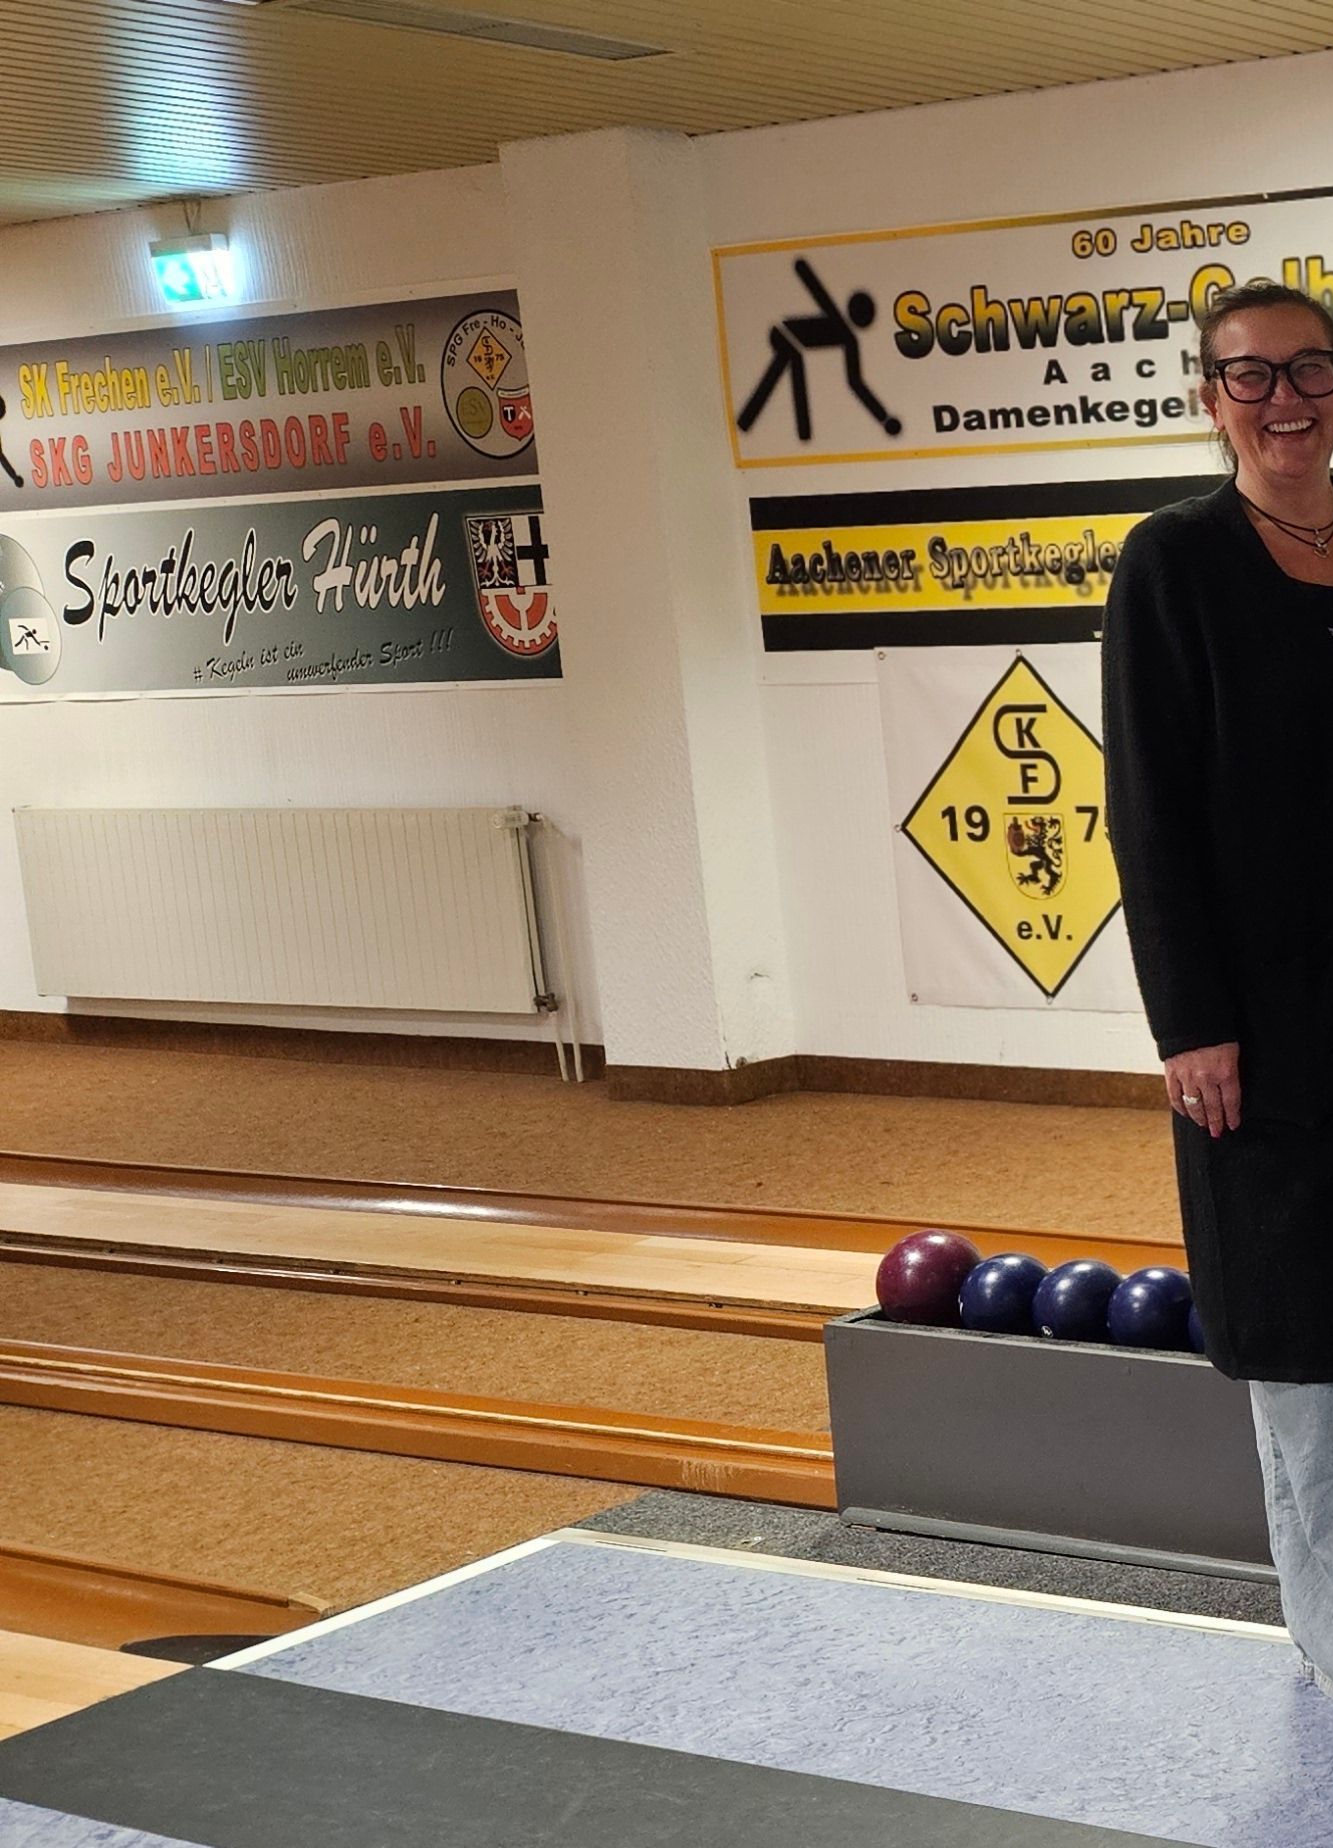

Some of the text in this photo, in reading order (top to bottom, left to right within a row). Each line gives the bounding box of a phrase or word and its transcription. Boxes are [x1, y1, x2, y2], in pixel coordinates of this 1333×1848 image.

[1072, 220, 1251, 260] 60 Jahre
[18, 363, 55, 419] SK
[55, 355, 152, 416] Frechen
[154, 348, 201, 407] e.V.
[217, 339, 267, 401] ESV
[272, 336, 371, 395] Horrem
[375, 323, 427, 386] e.V.
[29, 405, 437, 489] SKG JUNKERSDORF e.V.
[62, 511, 447, 646] Sportkegler Hürth
[765, 529, 1128, 589] Aachener Sportkegle
[206, 650, 256, 681] Kegeln
[260, 648, 279, 668] ist
[283, 640, 304, 662] ein
[286, 626, 455, 684] umwerfender Sport !!!
[941, 805, 1099, 842] 19 7
[1016, 914, 1073, 940] e.V.
